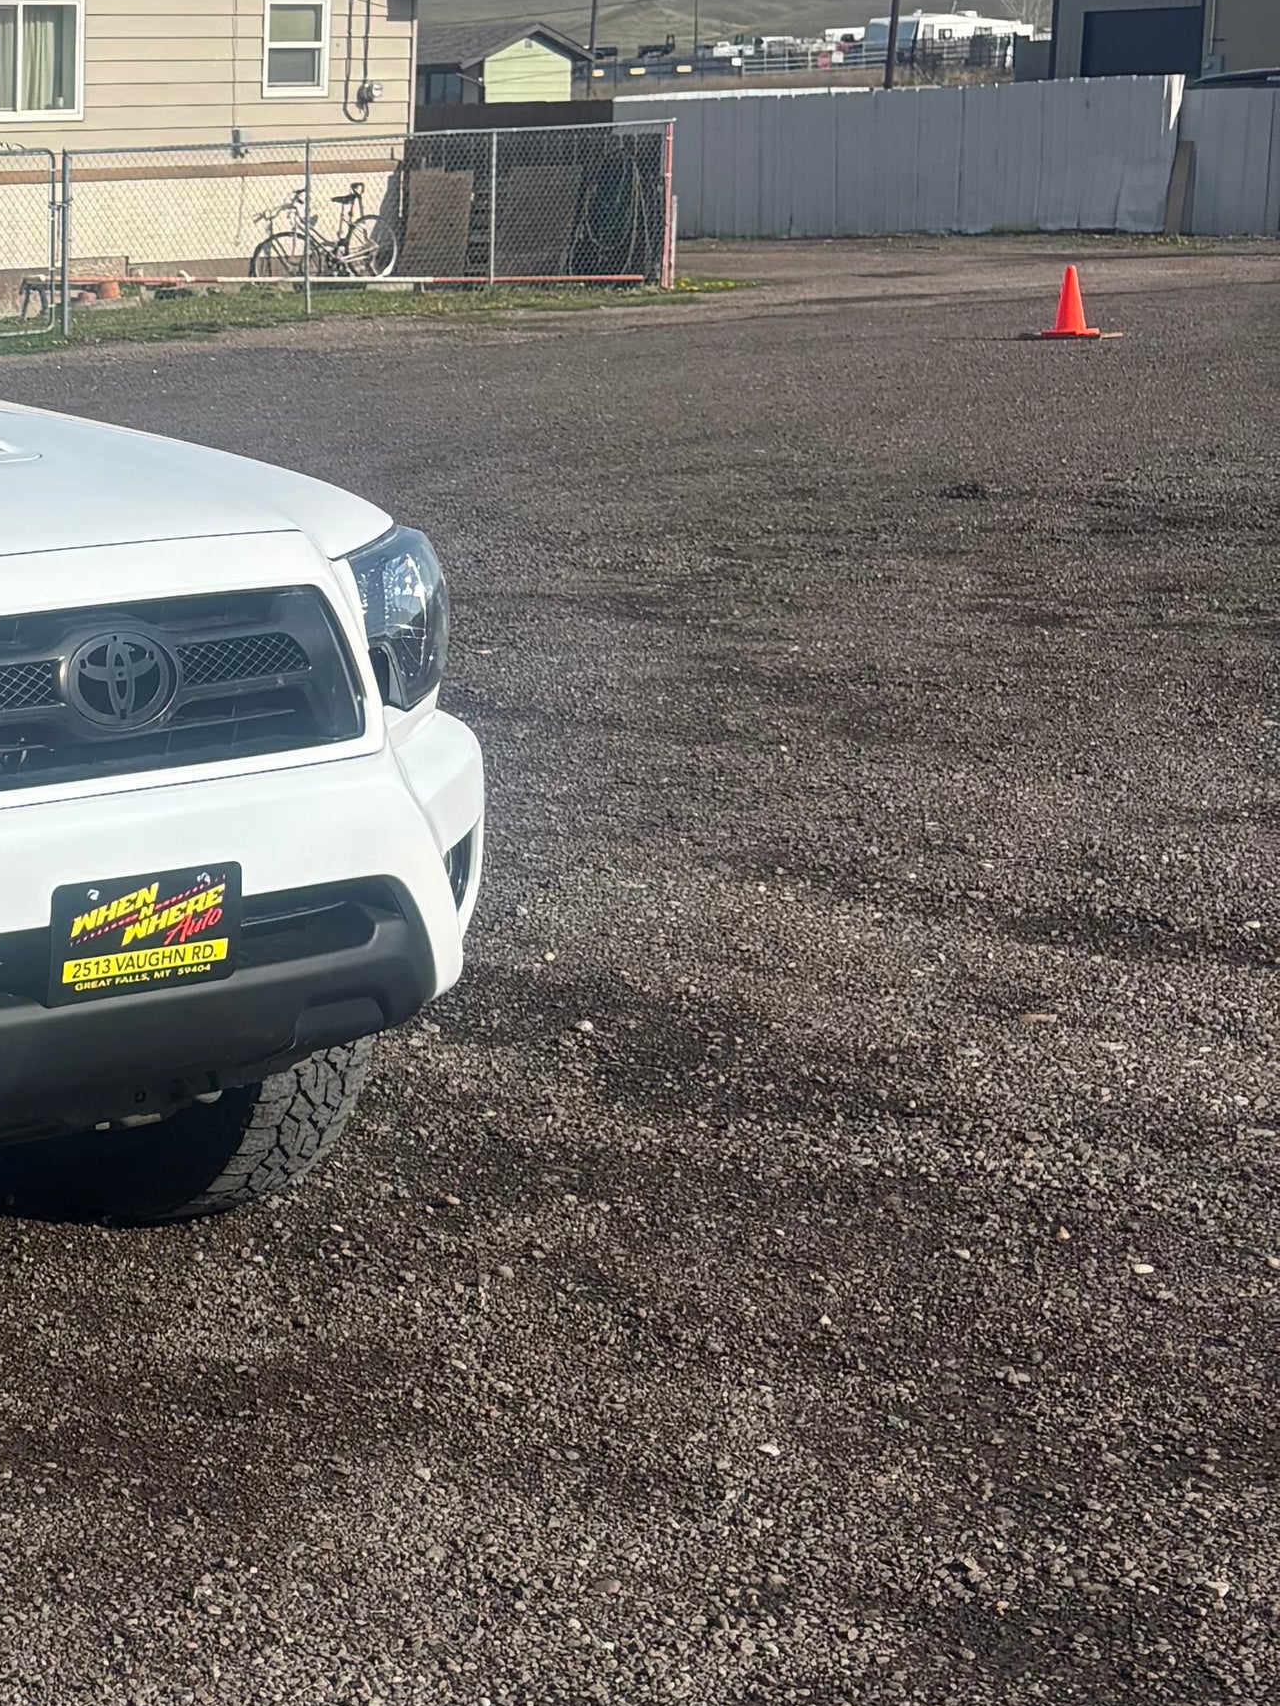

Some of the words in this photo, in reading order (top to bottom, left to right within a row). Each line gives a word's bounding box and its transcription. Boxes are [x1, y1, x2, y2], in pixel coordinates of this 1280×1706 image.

[70, 882, 159, 938] WHEN
[121, 883, 226, 948] WHERE
[139, 904, 155, 920] N
[163, 908, 223, 946] Auto
[72, 958, 111, 979] 2513
[112, 947, 186, 971] VAUGHN
[191, 944, 218, 961] RD.
[74, 978, 112, 992] GREAT
[115, 973, 151, 985] FALLS,
[153, 969, 172, 980] MT
[177, 963, 211, 976] 59404
